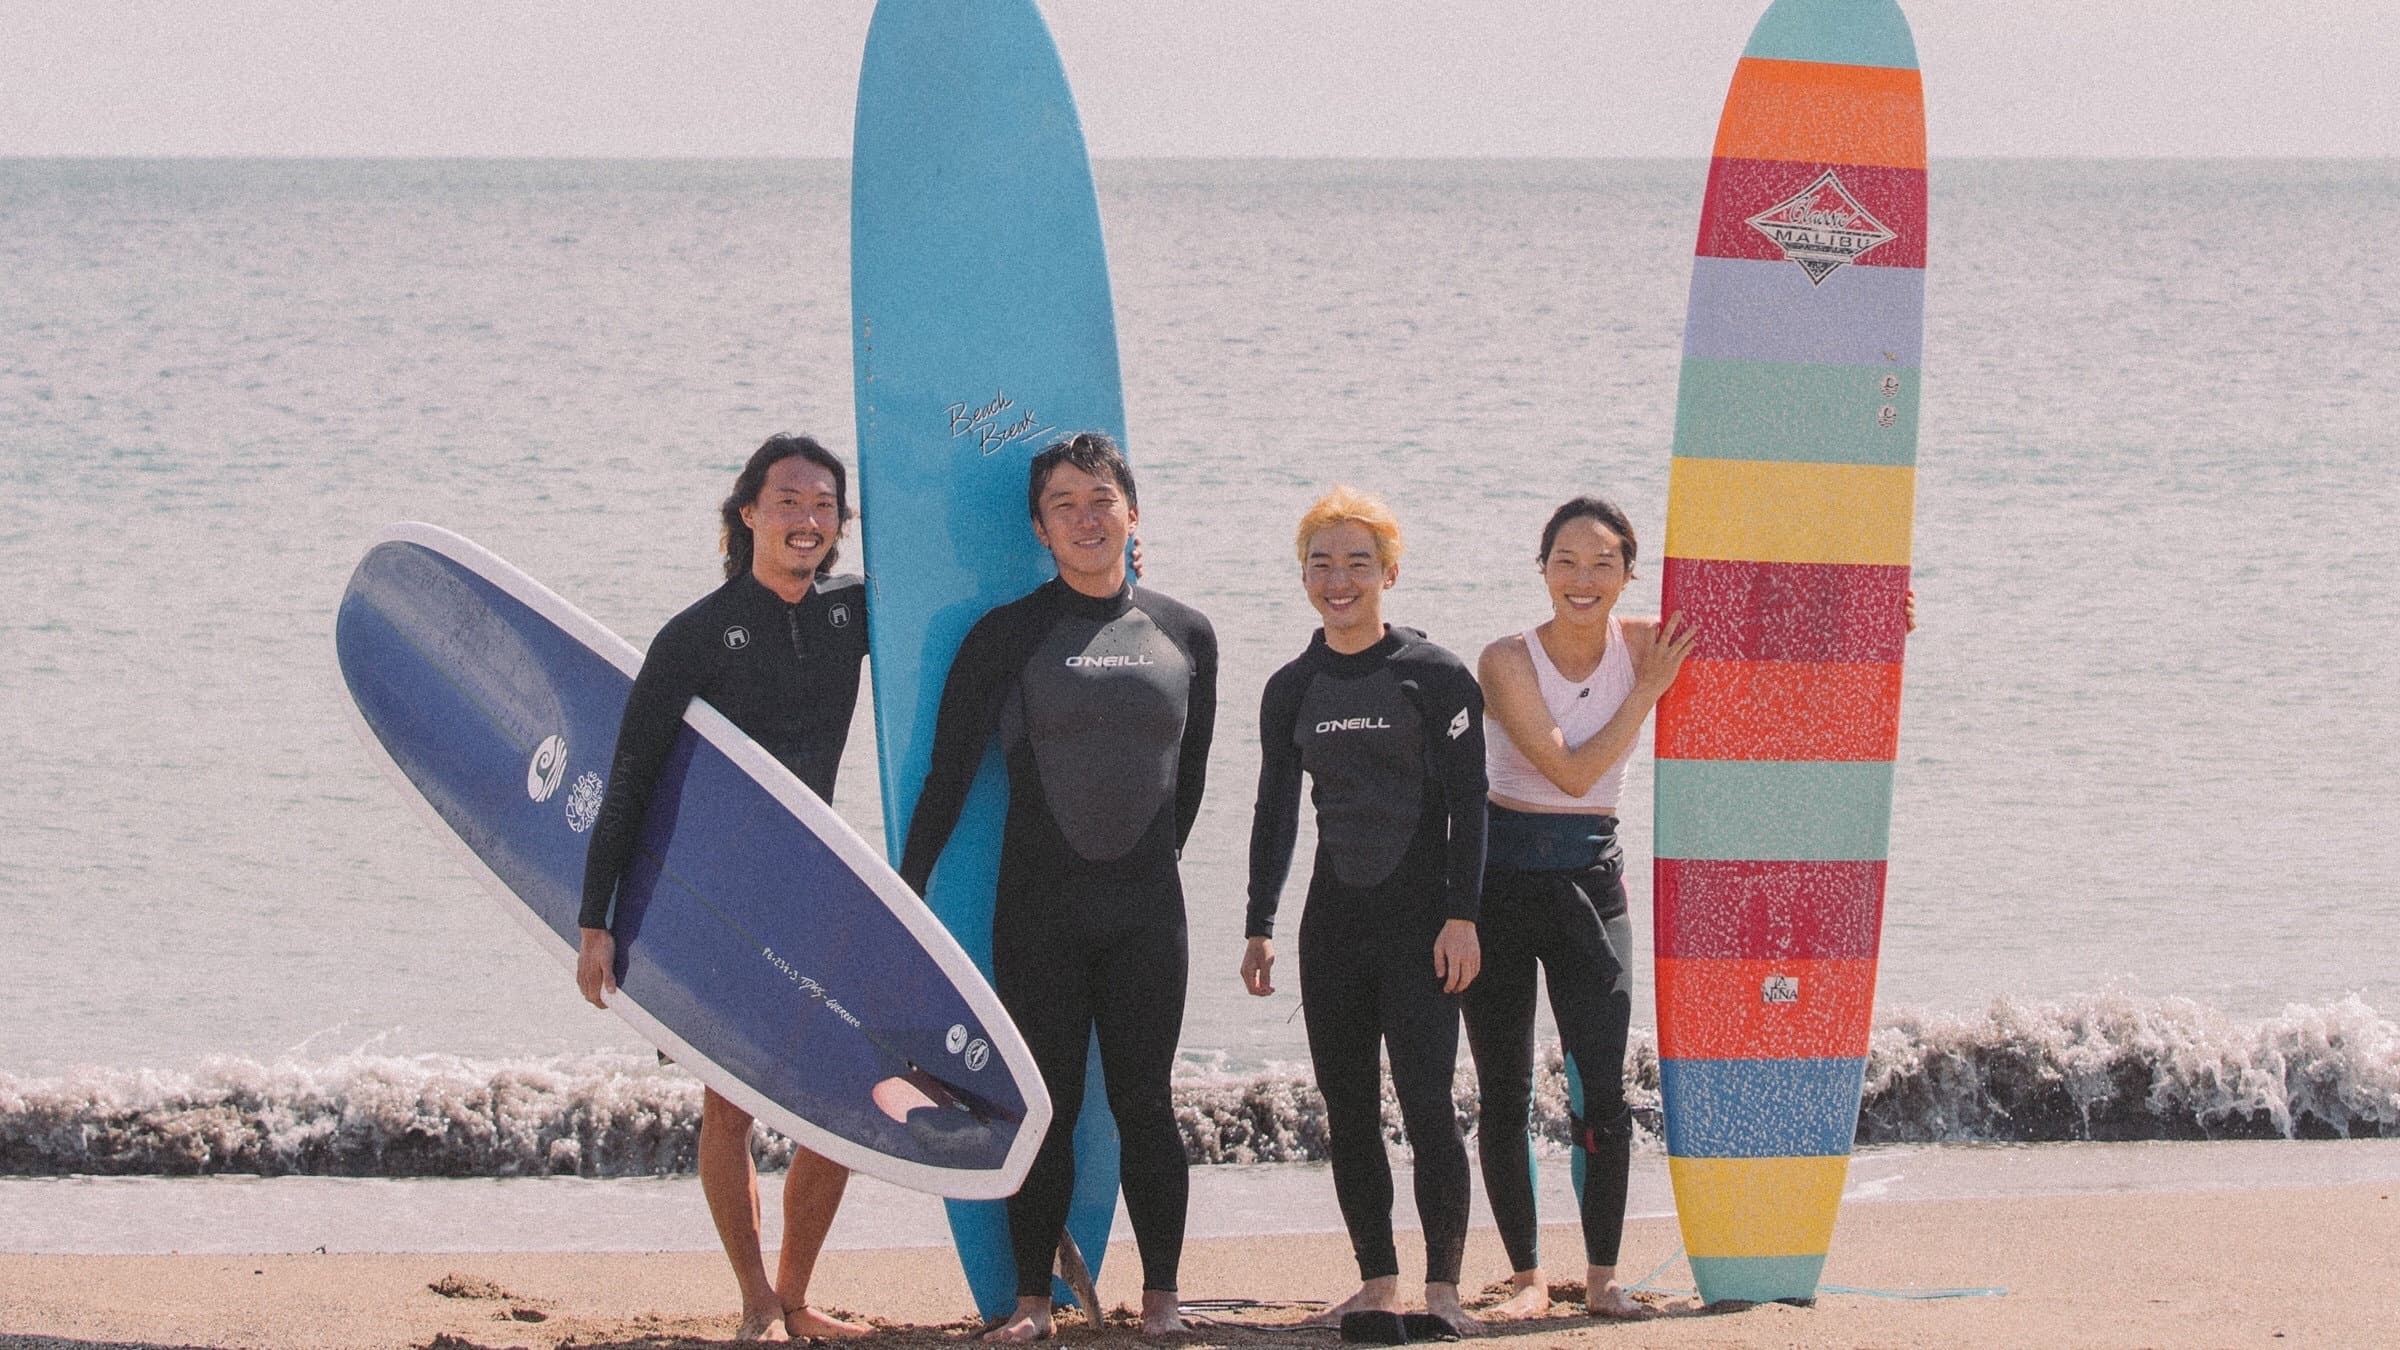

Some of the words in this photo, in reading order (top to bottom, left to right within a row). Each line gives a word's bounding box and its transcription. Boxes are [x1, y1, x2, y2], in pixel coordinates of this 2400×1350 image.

[1775, 229, 1871, 250] MALIBU
[943, 386, 1014, 438] Beach
[974, 409, 1040, 457] Break
[1065, 654, 1154, 668] O'NEILL
[1315, 717, 1391, 733] O'NEILL
